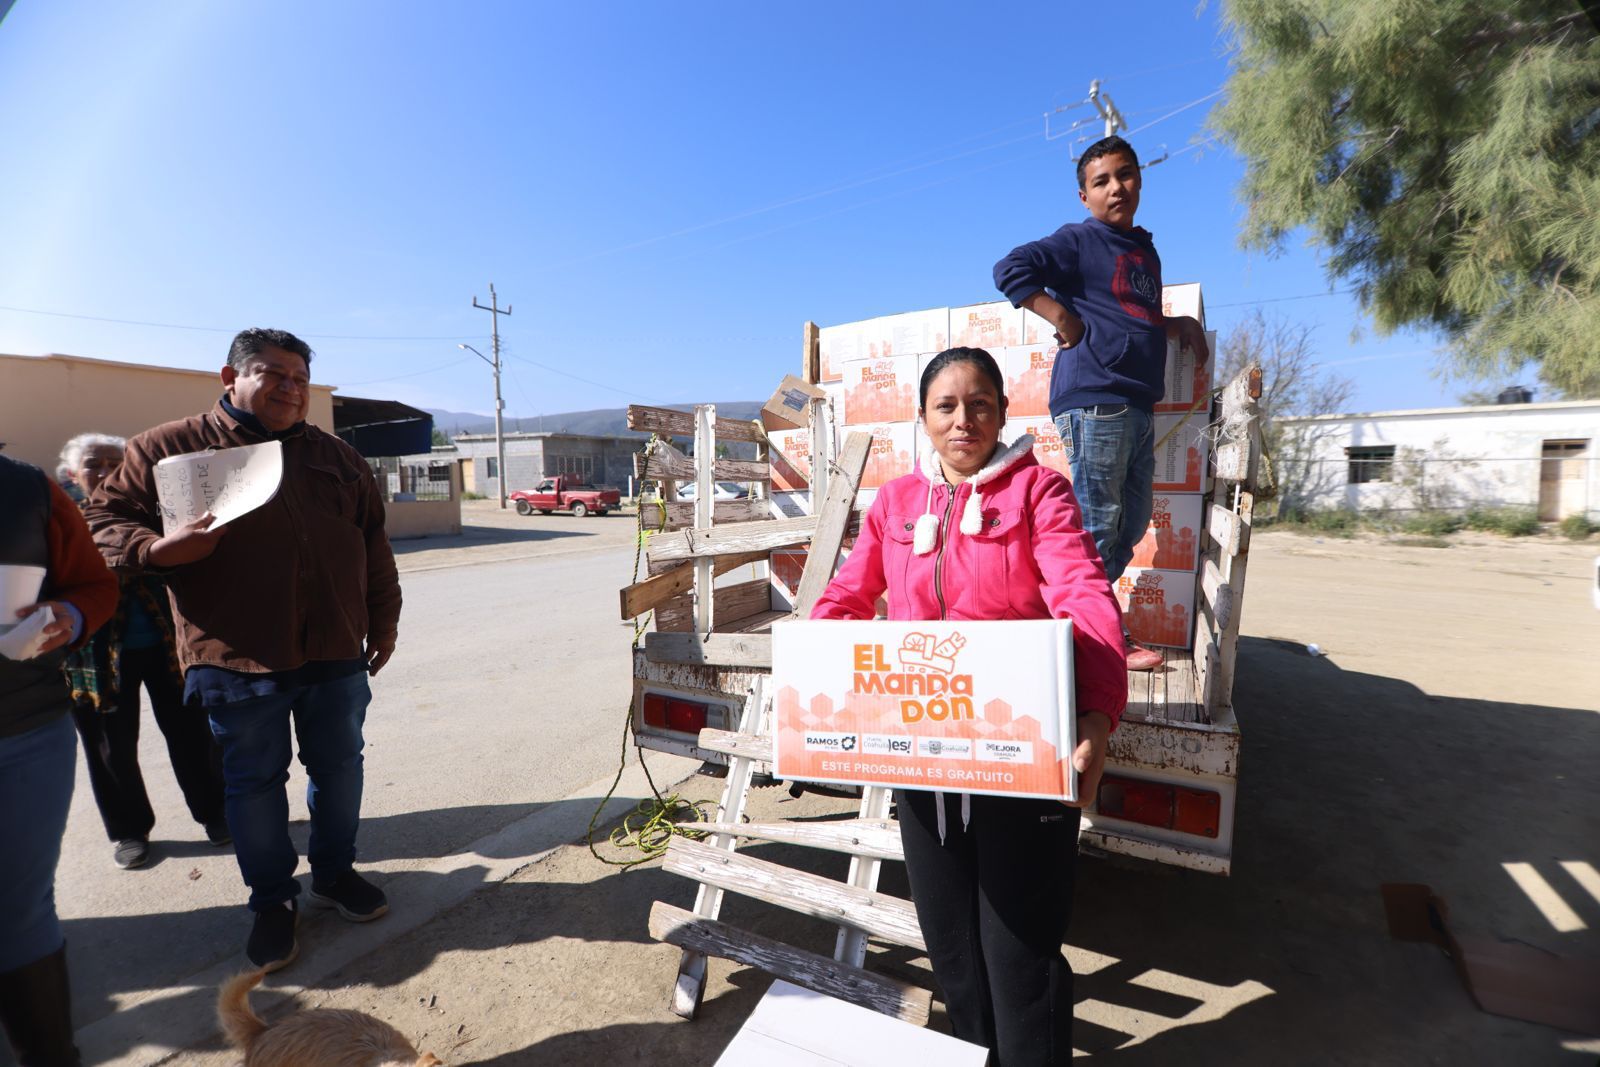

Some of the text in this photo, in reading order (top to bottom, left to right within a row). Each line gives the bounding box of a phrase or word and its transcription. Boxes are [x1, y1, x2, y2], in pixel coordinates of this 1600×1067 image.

[968, 312, 980, 321] EL
[1030, 352, 1044, 362] EL
[862, 367, 873, 376] EL
[1026, 427, 1040, 437] EL
[1119, 577, 1134, 587] EL
[854, 644, 891, 671] EL
[806, 737, 838, 746] RAMOS
[821, 761, 1014, 784] ESTE PROGRAMA ES GRATUITO
